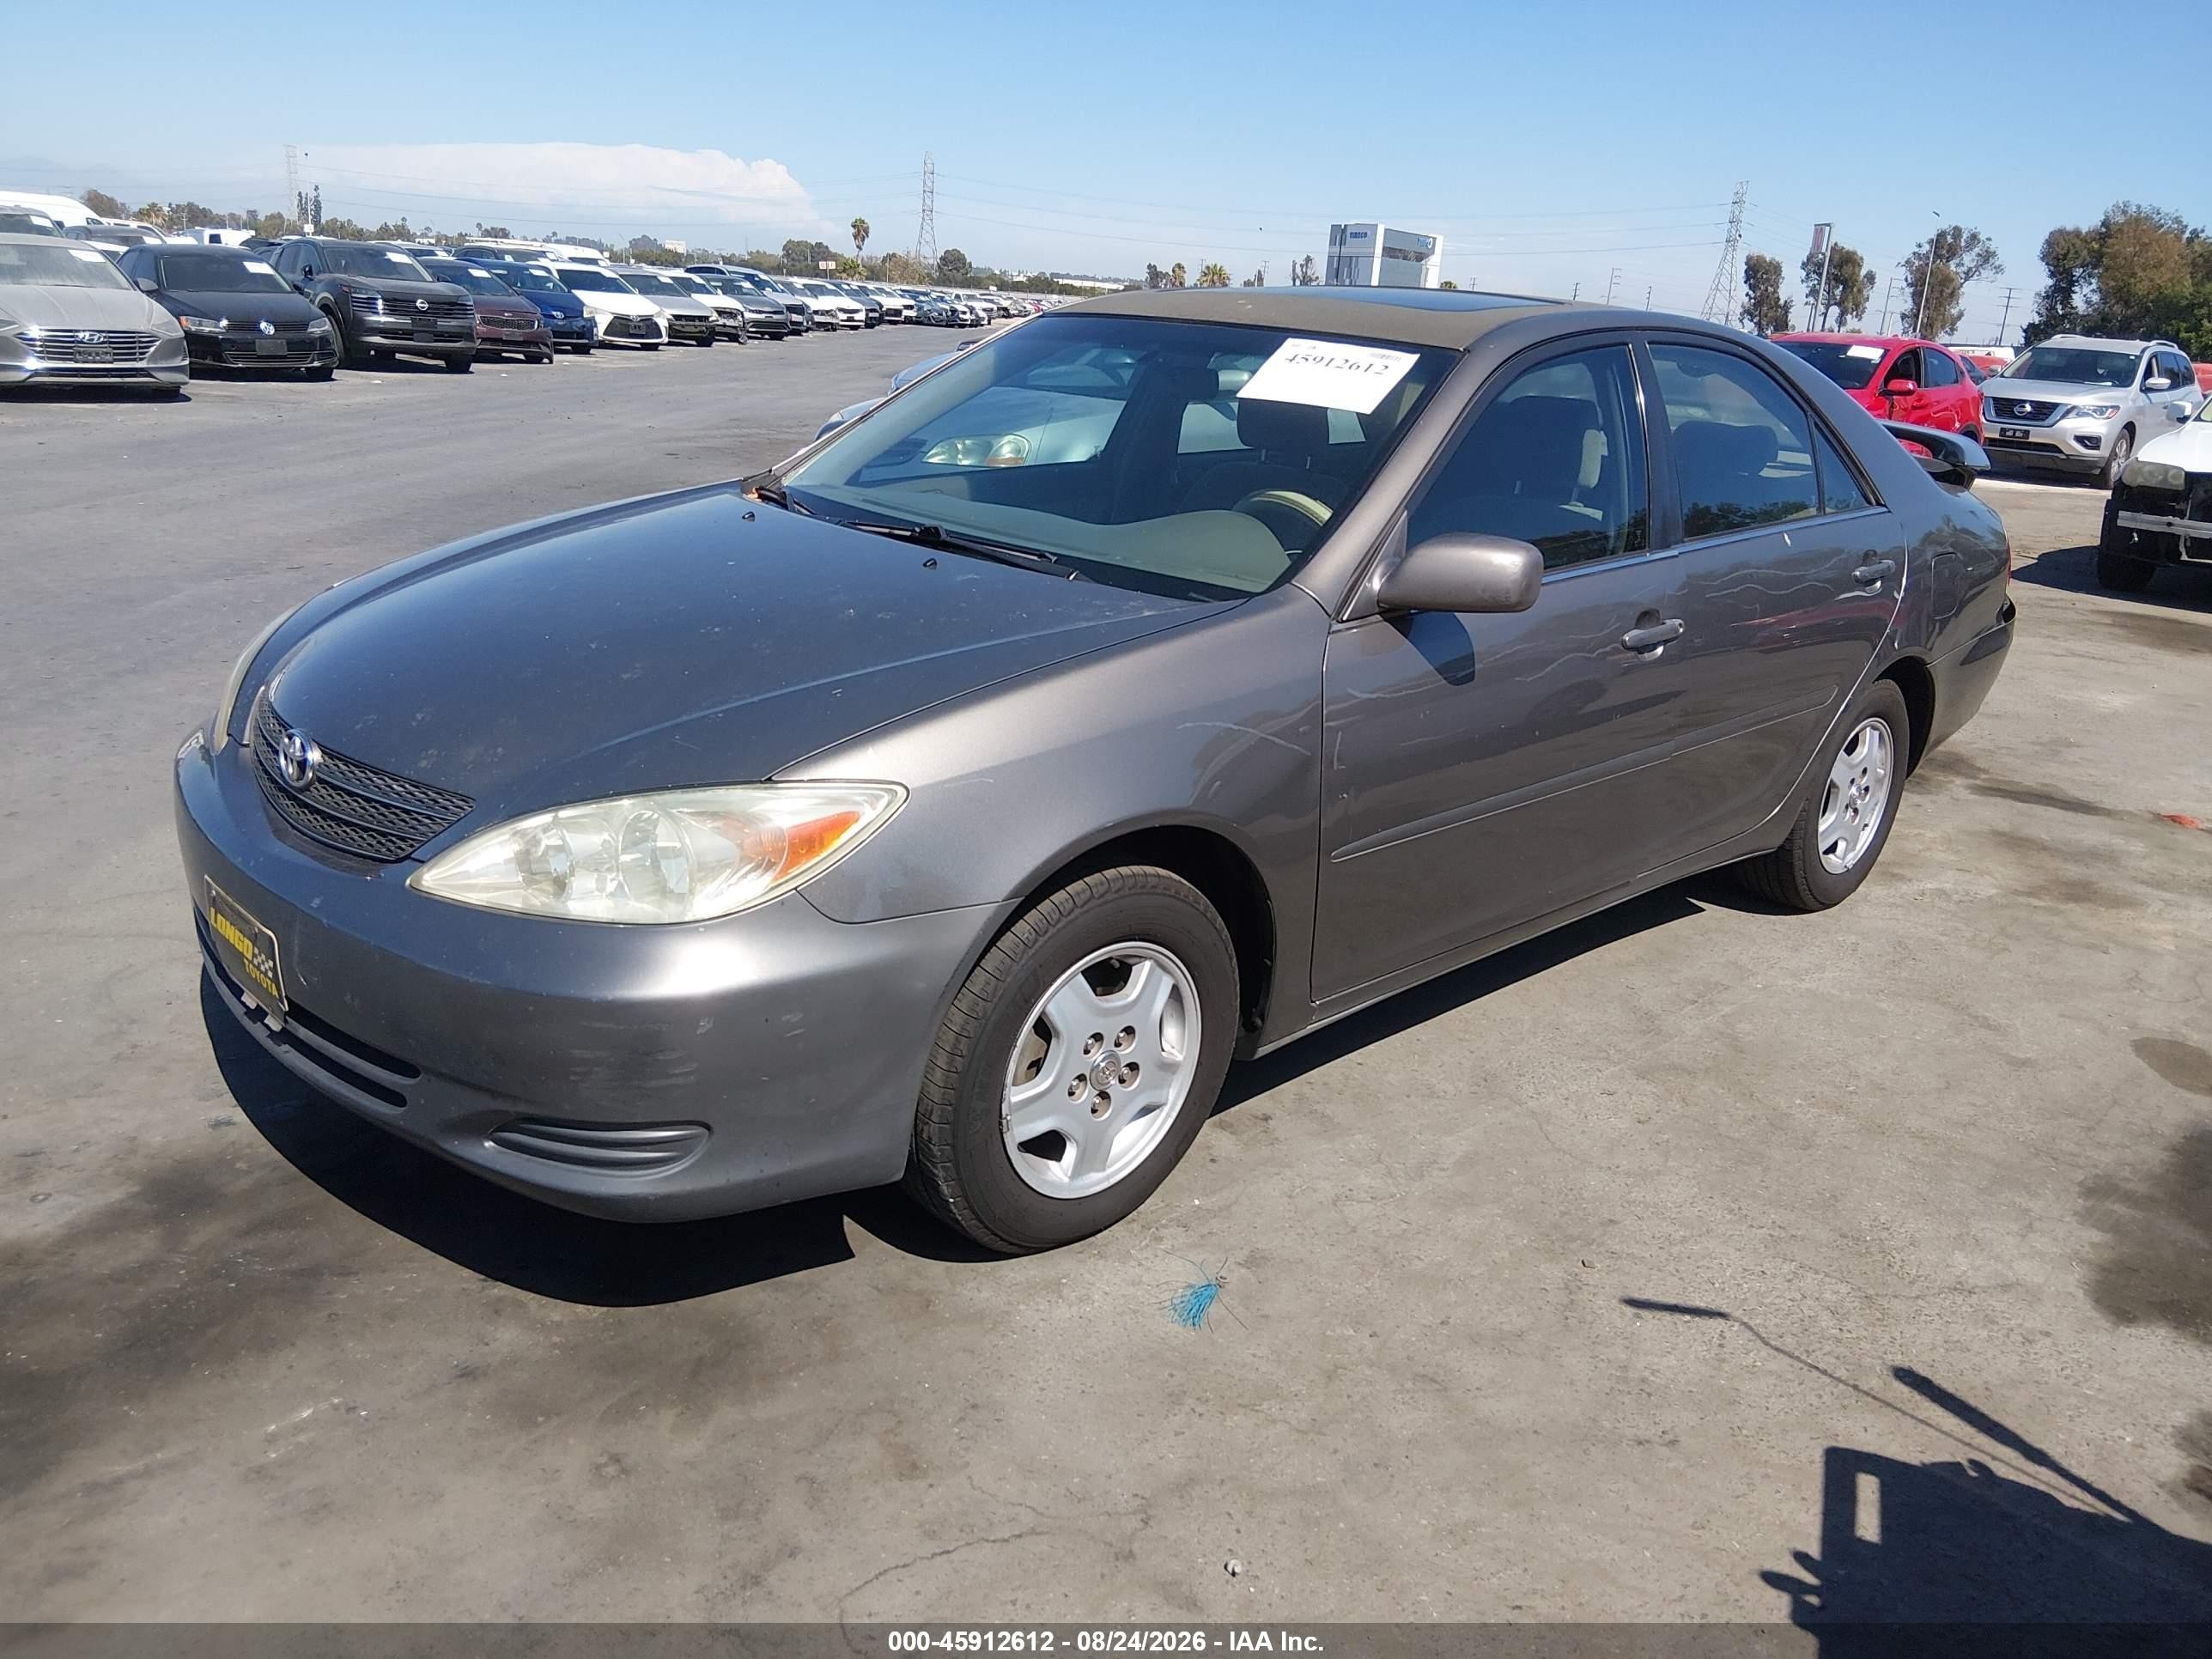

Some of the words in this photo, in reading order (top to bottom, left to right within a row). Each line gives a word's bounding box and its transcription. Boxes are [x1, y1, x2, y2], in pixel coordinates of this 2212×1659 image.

[1285, 353, 1389, 375] 45912612
[210, 907, 253, 960] LONGO
[244, 957, 279, 998] TOYOTA
